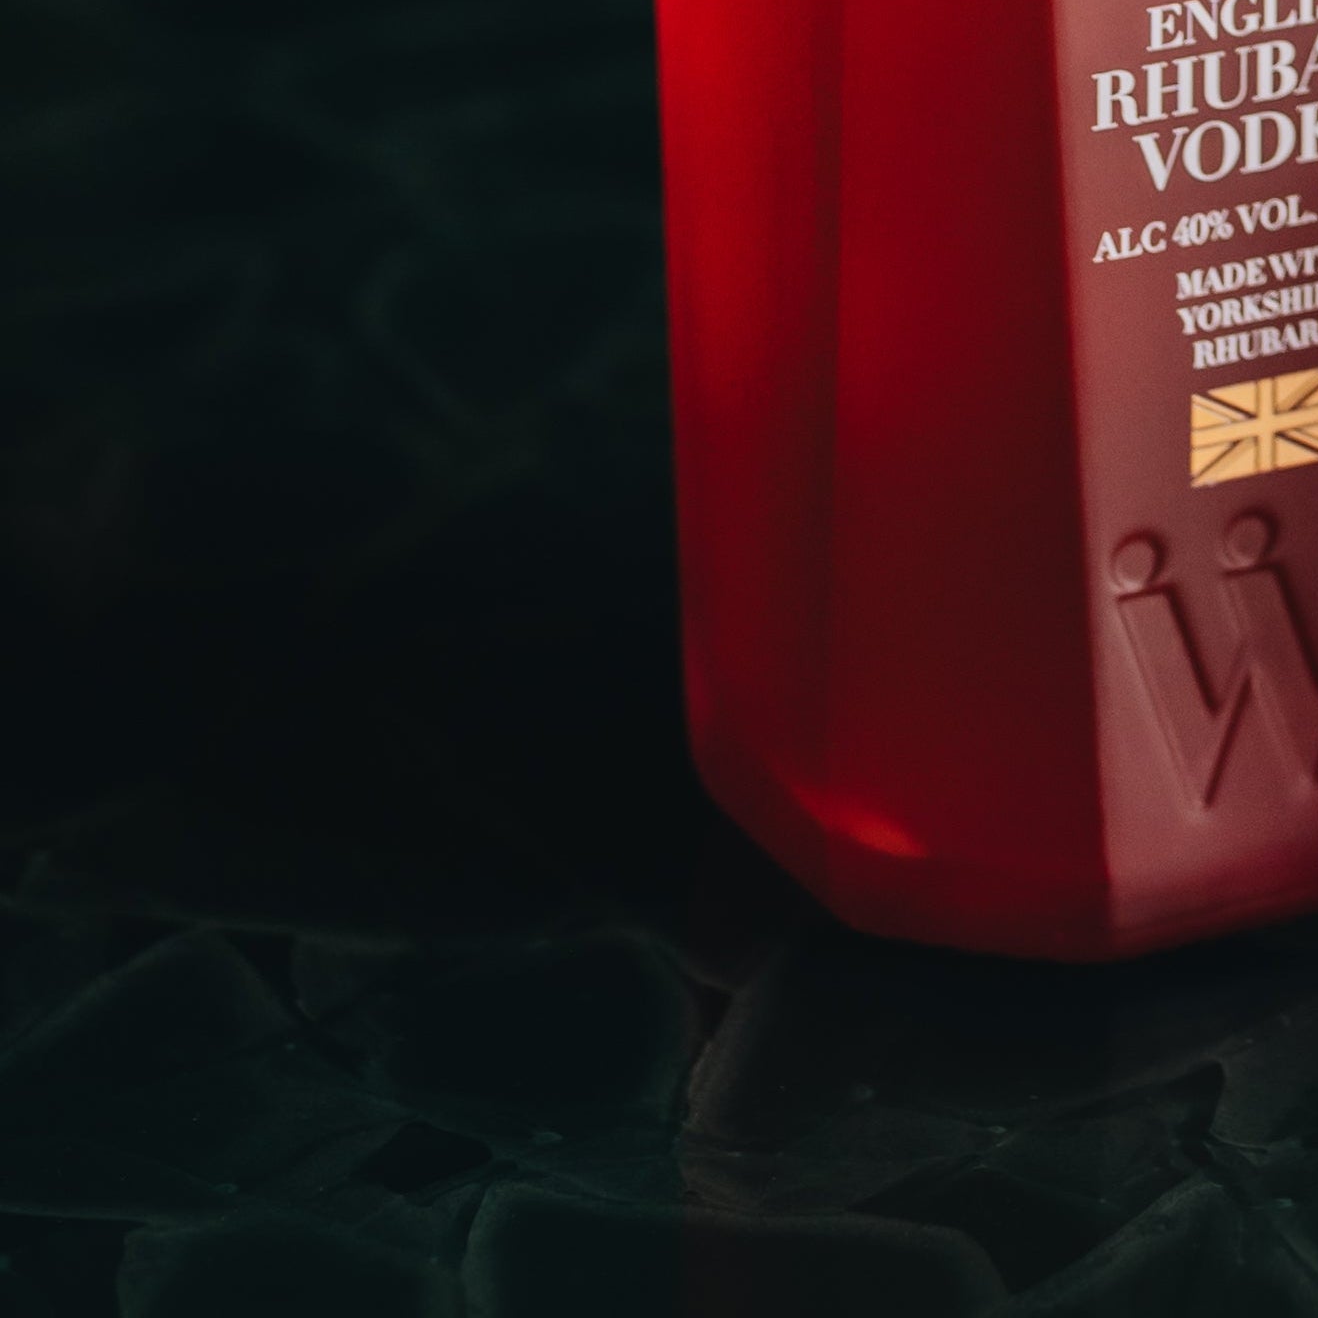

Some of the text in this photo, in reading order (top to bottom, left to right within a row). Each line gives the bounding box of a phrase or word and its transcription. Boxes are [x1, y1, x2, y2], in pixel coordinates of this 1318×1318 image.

[1092, 221, 1167, 263] ALC
[1171, 207, 1234, 245] 40%
[1176, 258, 1267, 301] MADE
